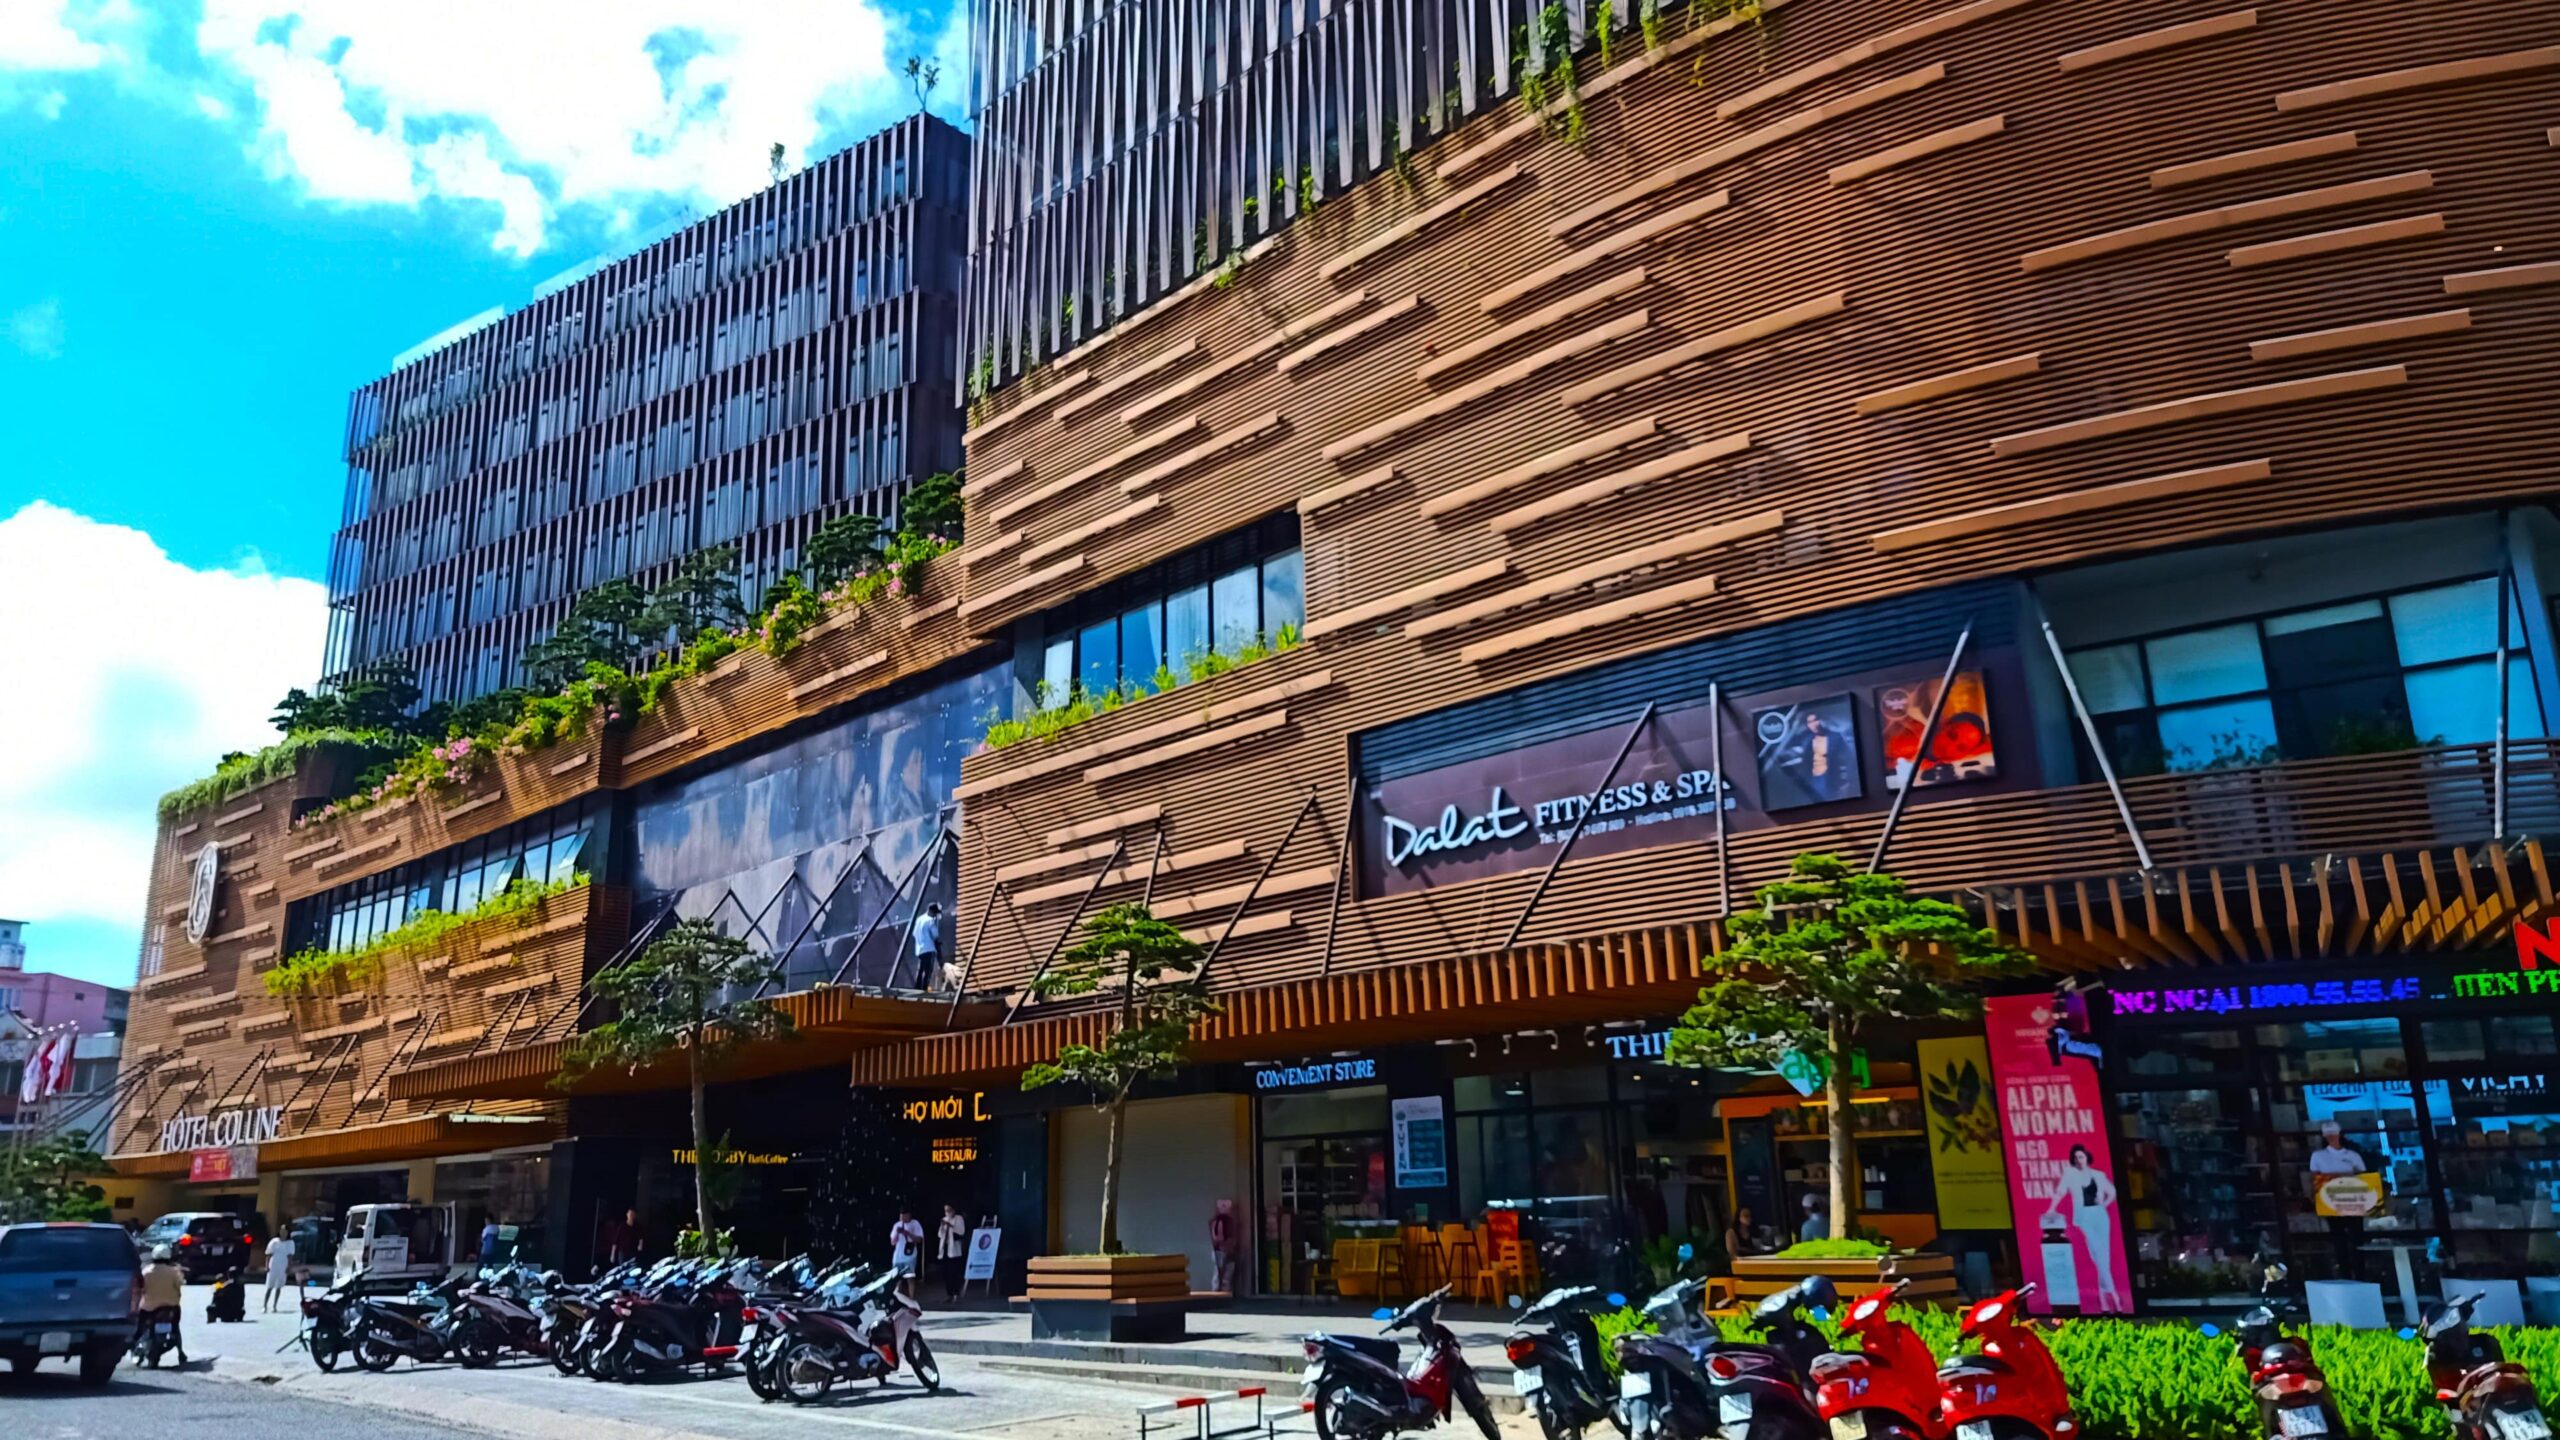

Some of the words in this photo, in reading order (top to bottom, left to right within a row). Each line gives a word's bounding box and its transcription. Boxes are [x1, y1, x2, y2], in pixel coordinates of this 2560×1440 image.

[1383, 786, 1529, 867] Dalat
[1535, 783, 1647, 827] FITNESS
[1651, 779, 1673, 804] &
[1677, 769, 1731, 798] SPA
[1256, 1065, 1333, 1088] CONVENIENT
[1334, 1059, 1376, 1081] STORE
[931, 1095, 963, 1119] MỚI
[2007, 1083, 2078, 1111] ALPHA
[161, 1109, 209, 1152] HÔTEL
[214, 1105, 283, 1147] COLLINE
[2008, 1109, 2095, 1137] WOMAN
